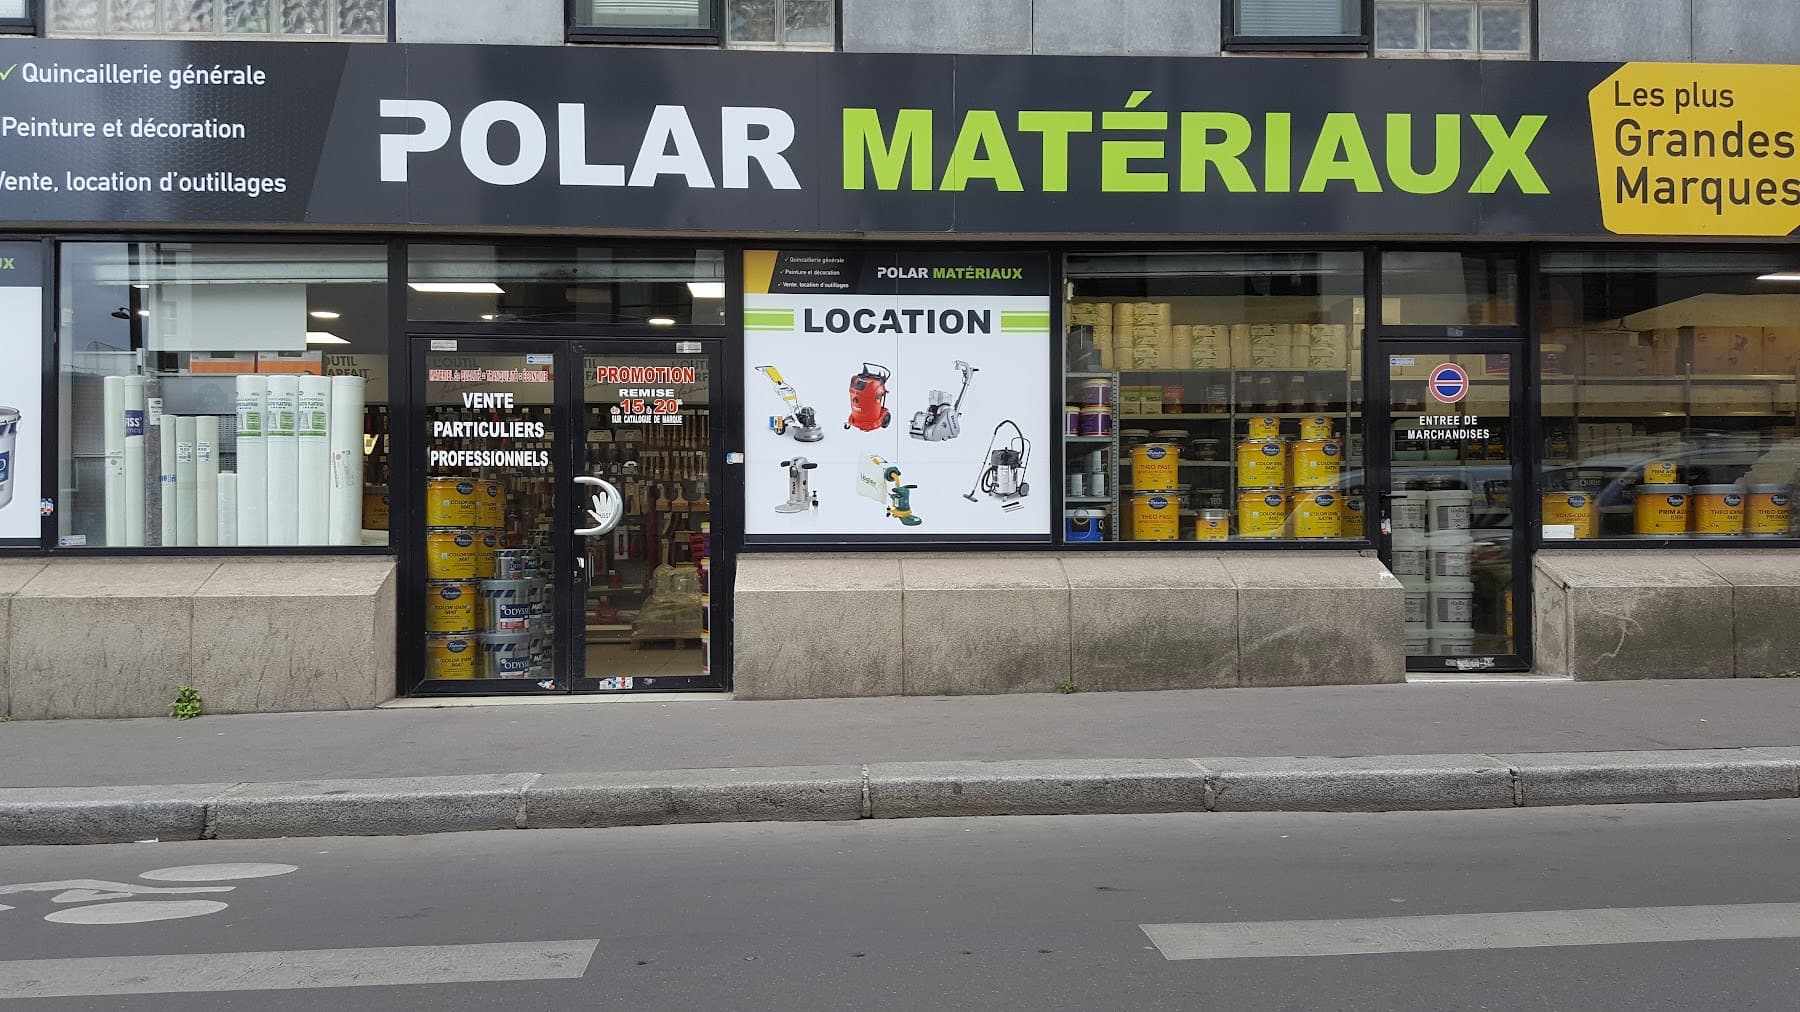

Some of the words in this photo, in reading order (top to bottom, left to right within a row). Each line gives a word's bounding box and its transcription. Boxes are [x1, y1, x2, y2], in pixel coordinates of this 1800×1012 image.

[22, 62, 162, 85] Quincaillerie
[168, 64, 266, 89] générale
[1614, 80, 1665, 107] Les
[1675, 81, 1734, 115] plus
[2, 116, 96, 137] Peinture
[103, 118, 124, 137] et
[130, 118, 246, 139] décoration
[379, 99, 802, 190] POLAR
[843, 91, 1551, 194] MATÉRIAUX
[1615, 118, 1795, 159] Grandes
[66, 171, 152, 192] location
[159, 171, 288, 197] d'outillages
[1616, 166, 1800, 216] Marques
[877, 266, 929, 279] POLAR
[933, 265, 1023, 280] MATÉRIAUX
[804, 307, 991, 334] LOCATION
[596, 366, 696, 383] PROMOTION
[462, 392, 514, 409] VENTE
[619, 388, 675, 397] REMISE
[620, 398, 645, 415] 15
[1419, 415, 1460, 426] ENTREE
[1464, 415, 1478, 425] DE
[433, 421, 545, 438] PARTICULIERS
[1407, 429, 1490, 440] MARCHANDISES
[430, 450, 549, 467] PROFESSIONNELS
